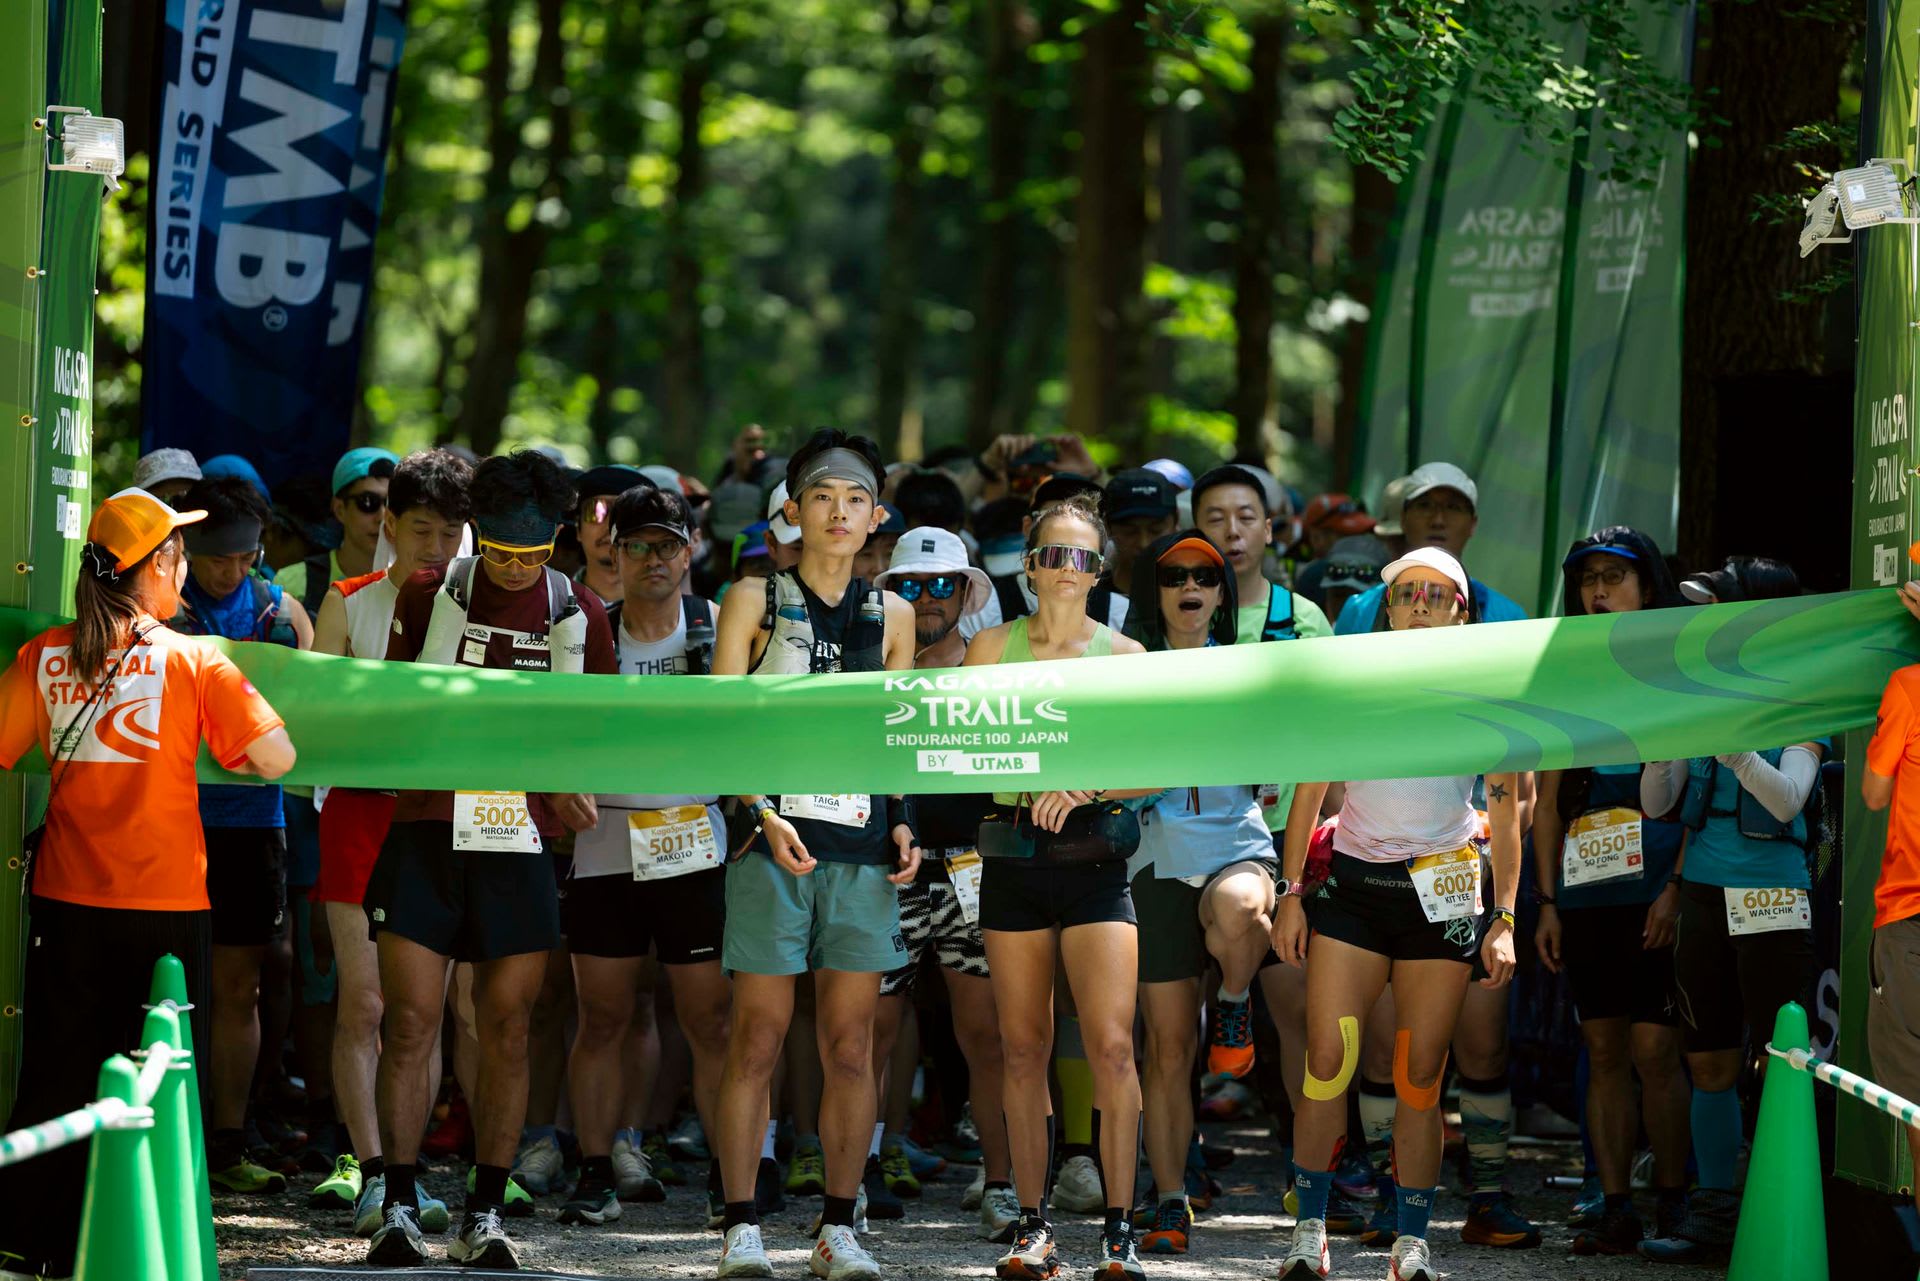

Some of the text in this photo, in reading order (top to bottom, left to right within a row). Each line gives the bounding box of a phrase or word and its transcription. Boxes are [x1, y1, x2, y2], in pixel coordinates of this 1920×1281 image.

[163, 109, 205, 281] SERIES
[54, 345, 89, 400] KAGASPA
[1871, 394, 1908, 448] KAGASPA
[60, 407, 81, 457] TRAIL
[1877, 454, 1900, 504] TRAIL
[1869, 516, 1888, 537] ENDURANCE
[514, 658, 548, 668] MAGMA
[635, 657, 673, 676] THE
[884, 669, 1065, 692] KAGASPA
[921, 696, 1033, 727] TRAIL
[886, 731, 1069, 747] ENDURANCE 100 JAPAN
[928, 754, 1025, 771] BY UTMB
[477, 796, 526, 806] KagaSpa20
[813, 795, 840, 807] TAIGA
[472, 806, 529, 827] 5002
[480, 826, 519, 836] HIROAKI
[651, 823, 693, 836] KagaSpa20
[649, 831, 695, 856] 5011
[1579, 834, 1626, 859] 6050
[656, 850, 693, 864] MAKOTO
[1584, 858, 1595, 867] SO
[1596, 854, 1619, 864] FONG
[1363, 876, 1415, 889] SALOMON
[1433, 872, 1476, 897] 6002
[1444, 893, 1471, 904] KIT YEE
[1743, 888, 1797, 910] 6025
[1749, 906, 1794, 918] WAN CHIK
